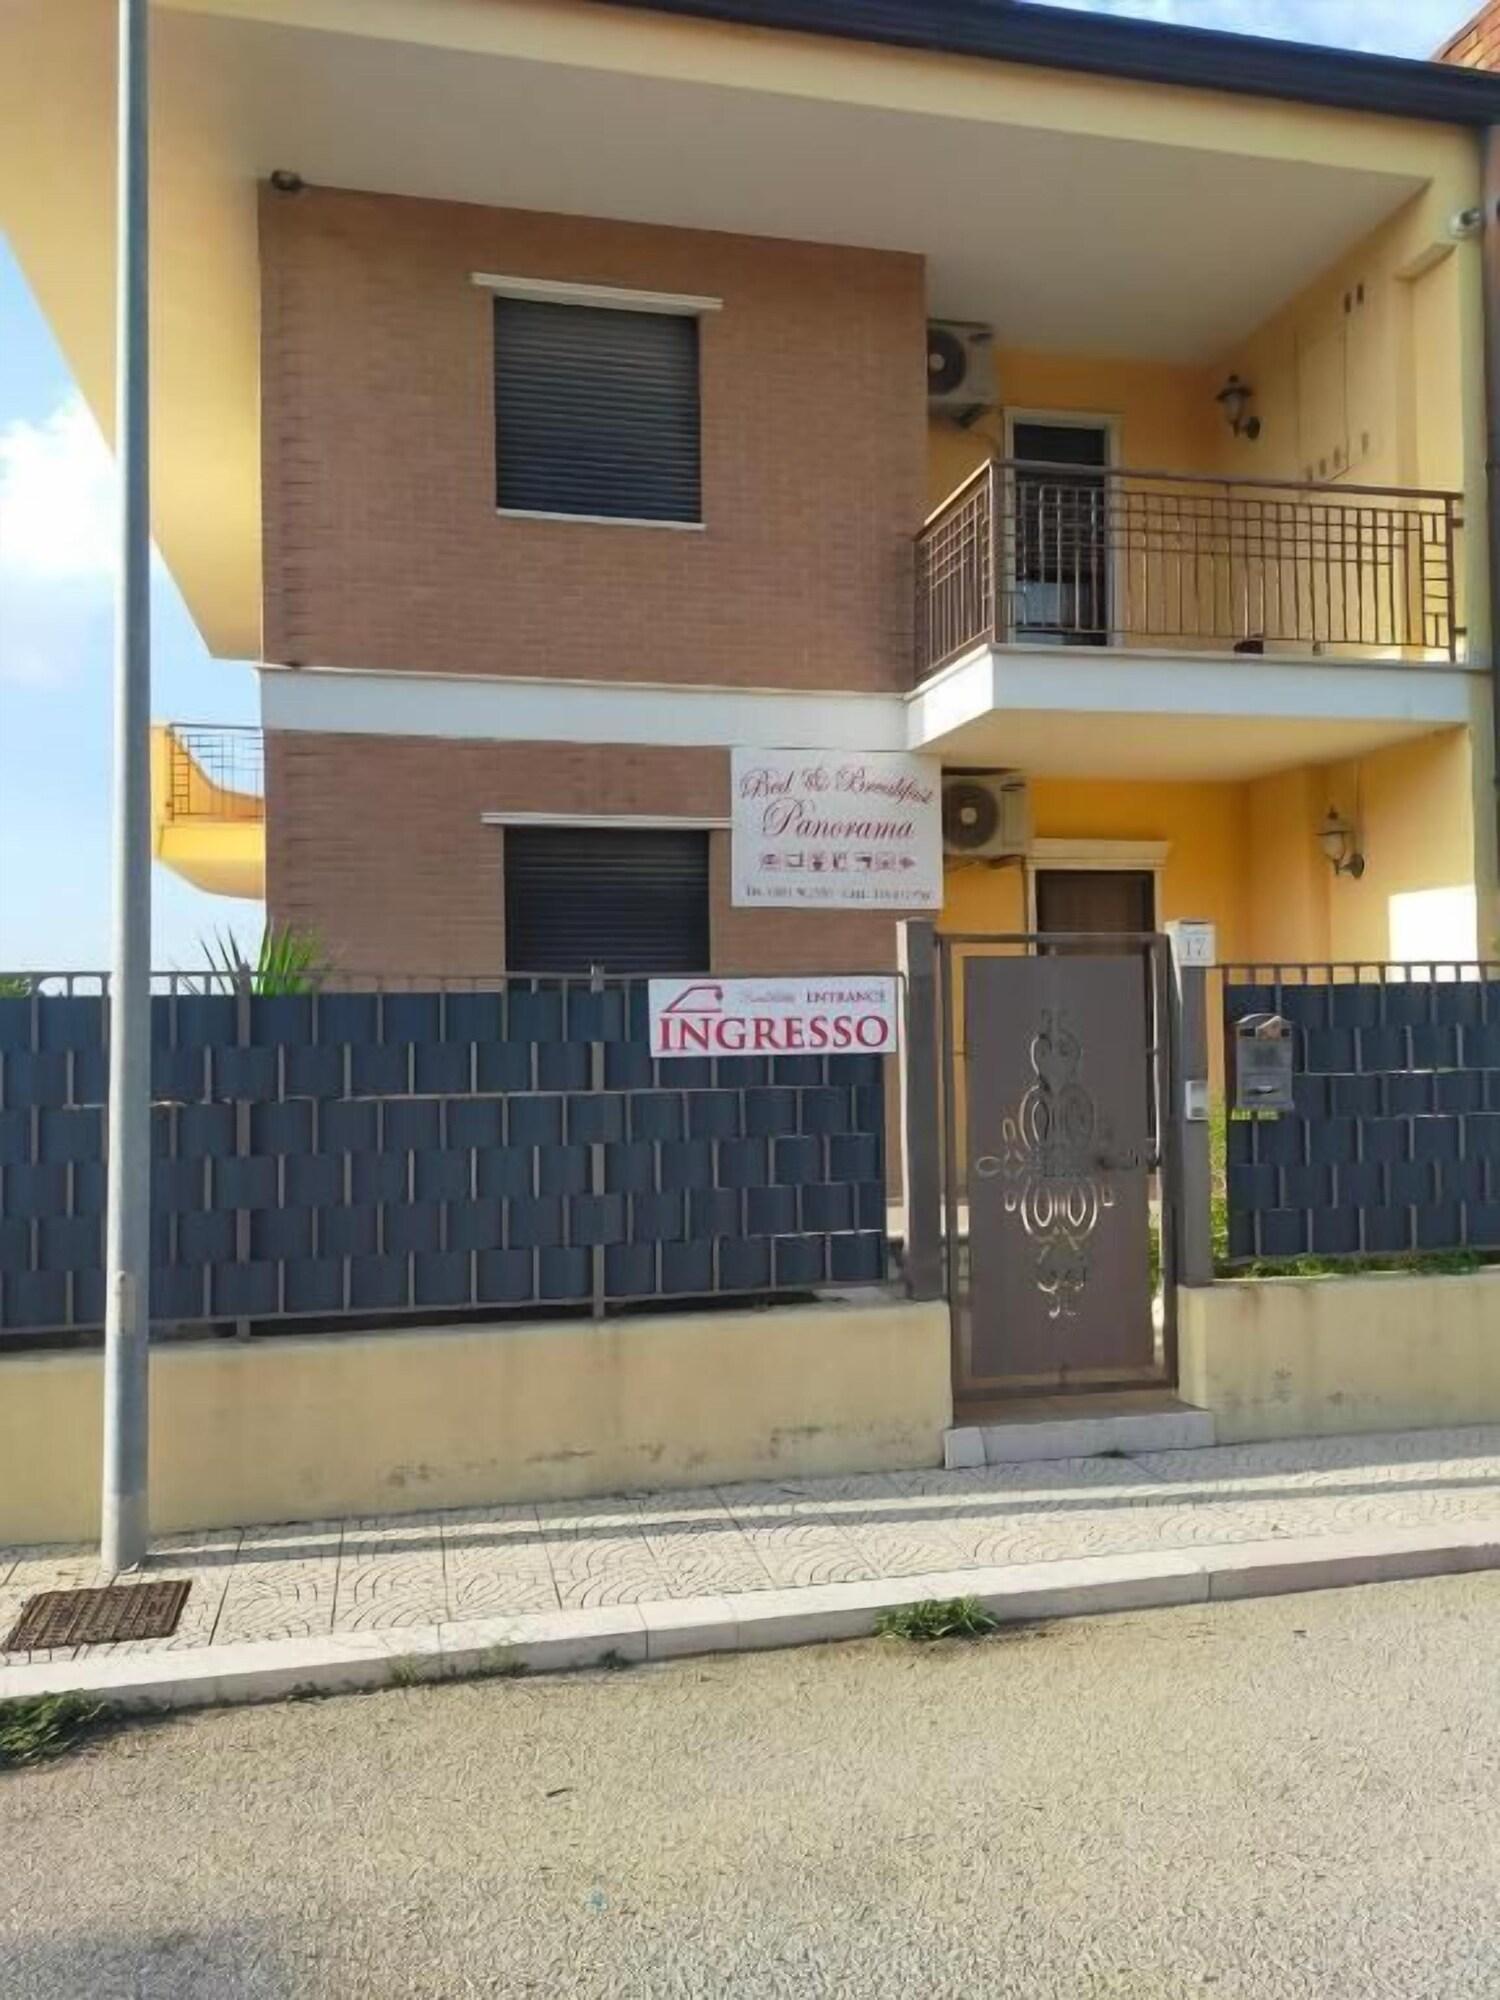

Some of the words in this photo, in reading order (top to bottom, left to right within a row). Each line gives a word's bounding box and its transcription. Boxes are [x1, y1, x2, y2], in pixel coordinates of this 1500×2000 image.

[740, 768, 795, 799] Bed
[802, 766, 830, 792] &
[762, 798, 914, 839] Panorama
[1187, 937, 1207, 956] 17
[806, 989, 886, 1003] ENTRANCE
[659, 1015, 889, 1051] INGRESSO
